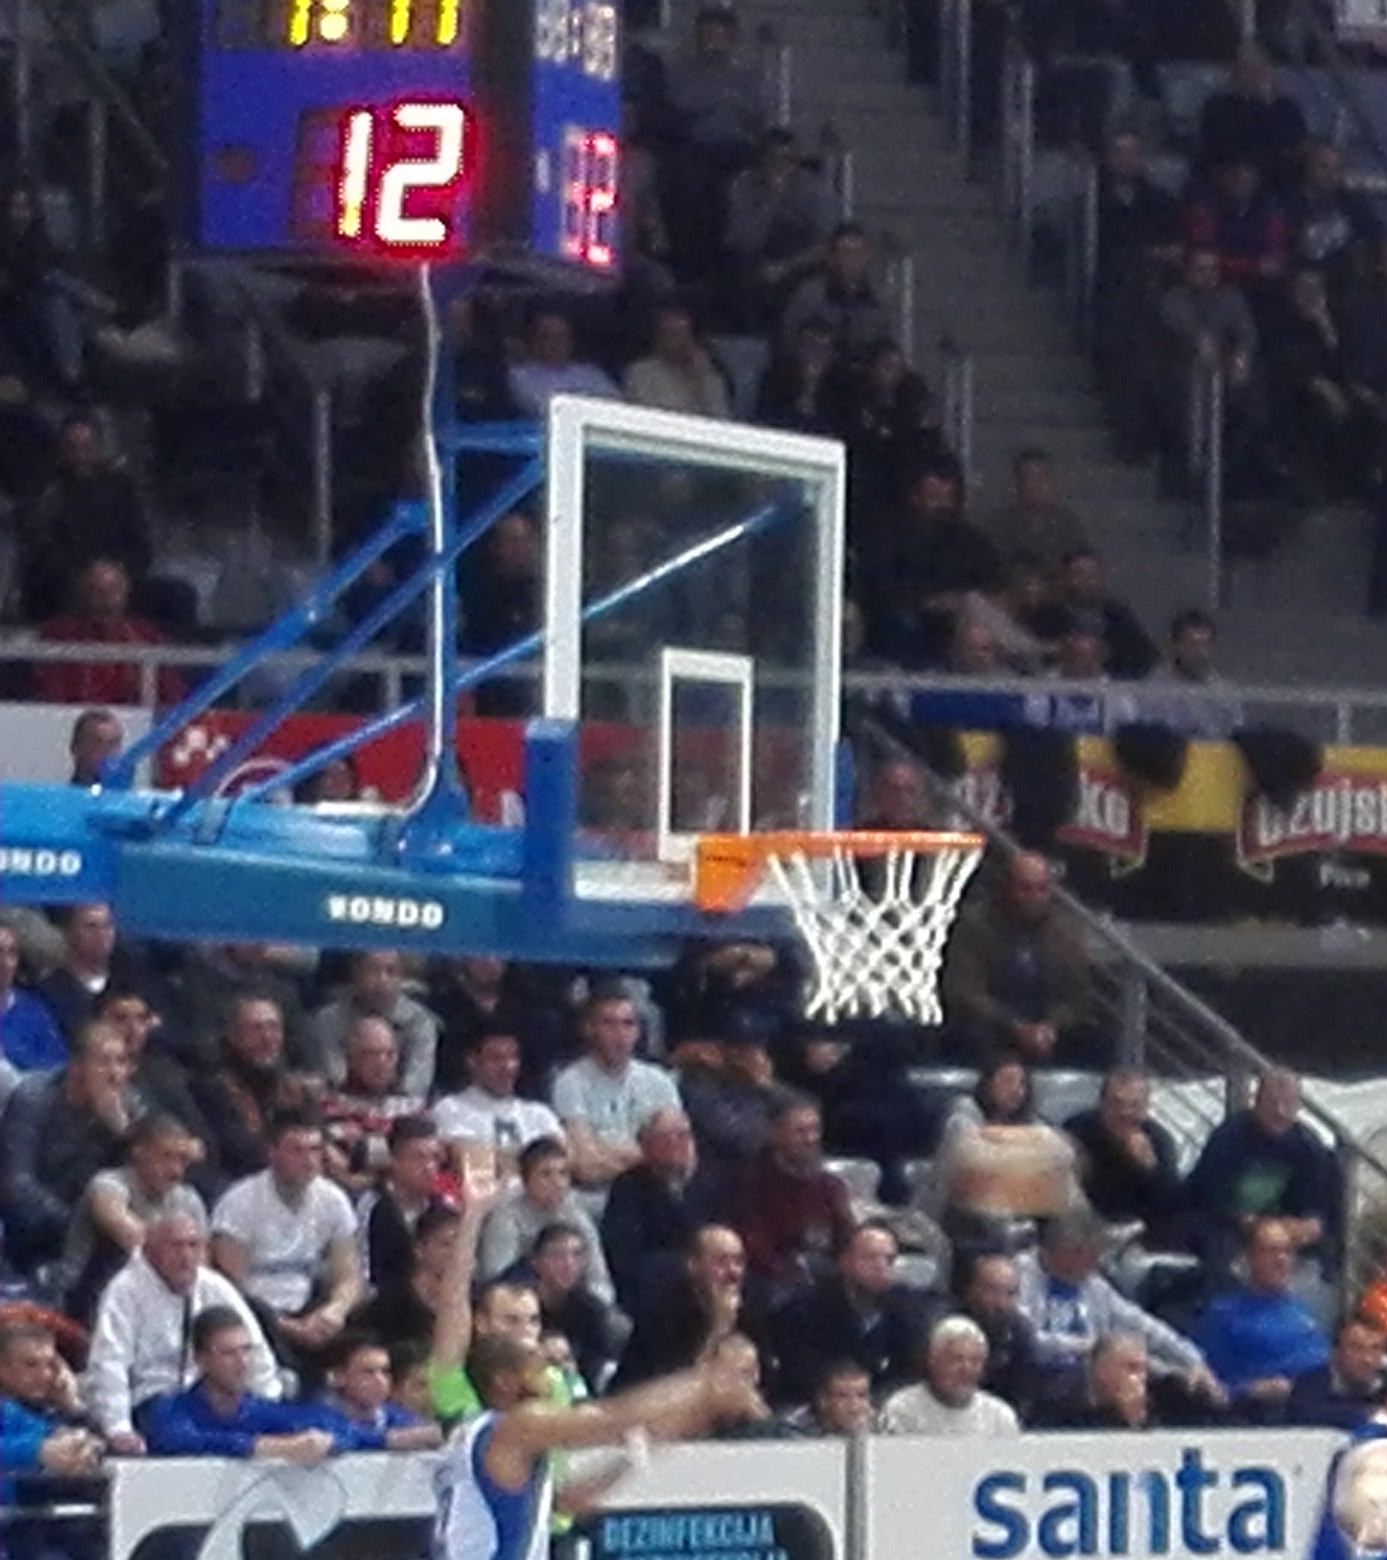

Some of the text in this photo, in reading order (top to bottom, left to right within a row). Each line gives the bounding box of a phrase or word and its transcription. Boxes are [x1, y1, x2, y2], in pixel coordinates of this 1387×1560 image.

[338, 102, 464, 246] 12
[604, 1512, 774, 1551] DEZINFEKCIJA
[971, 1446, 1287, 1560] santa
